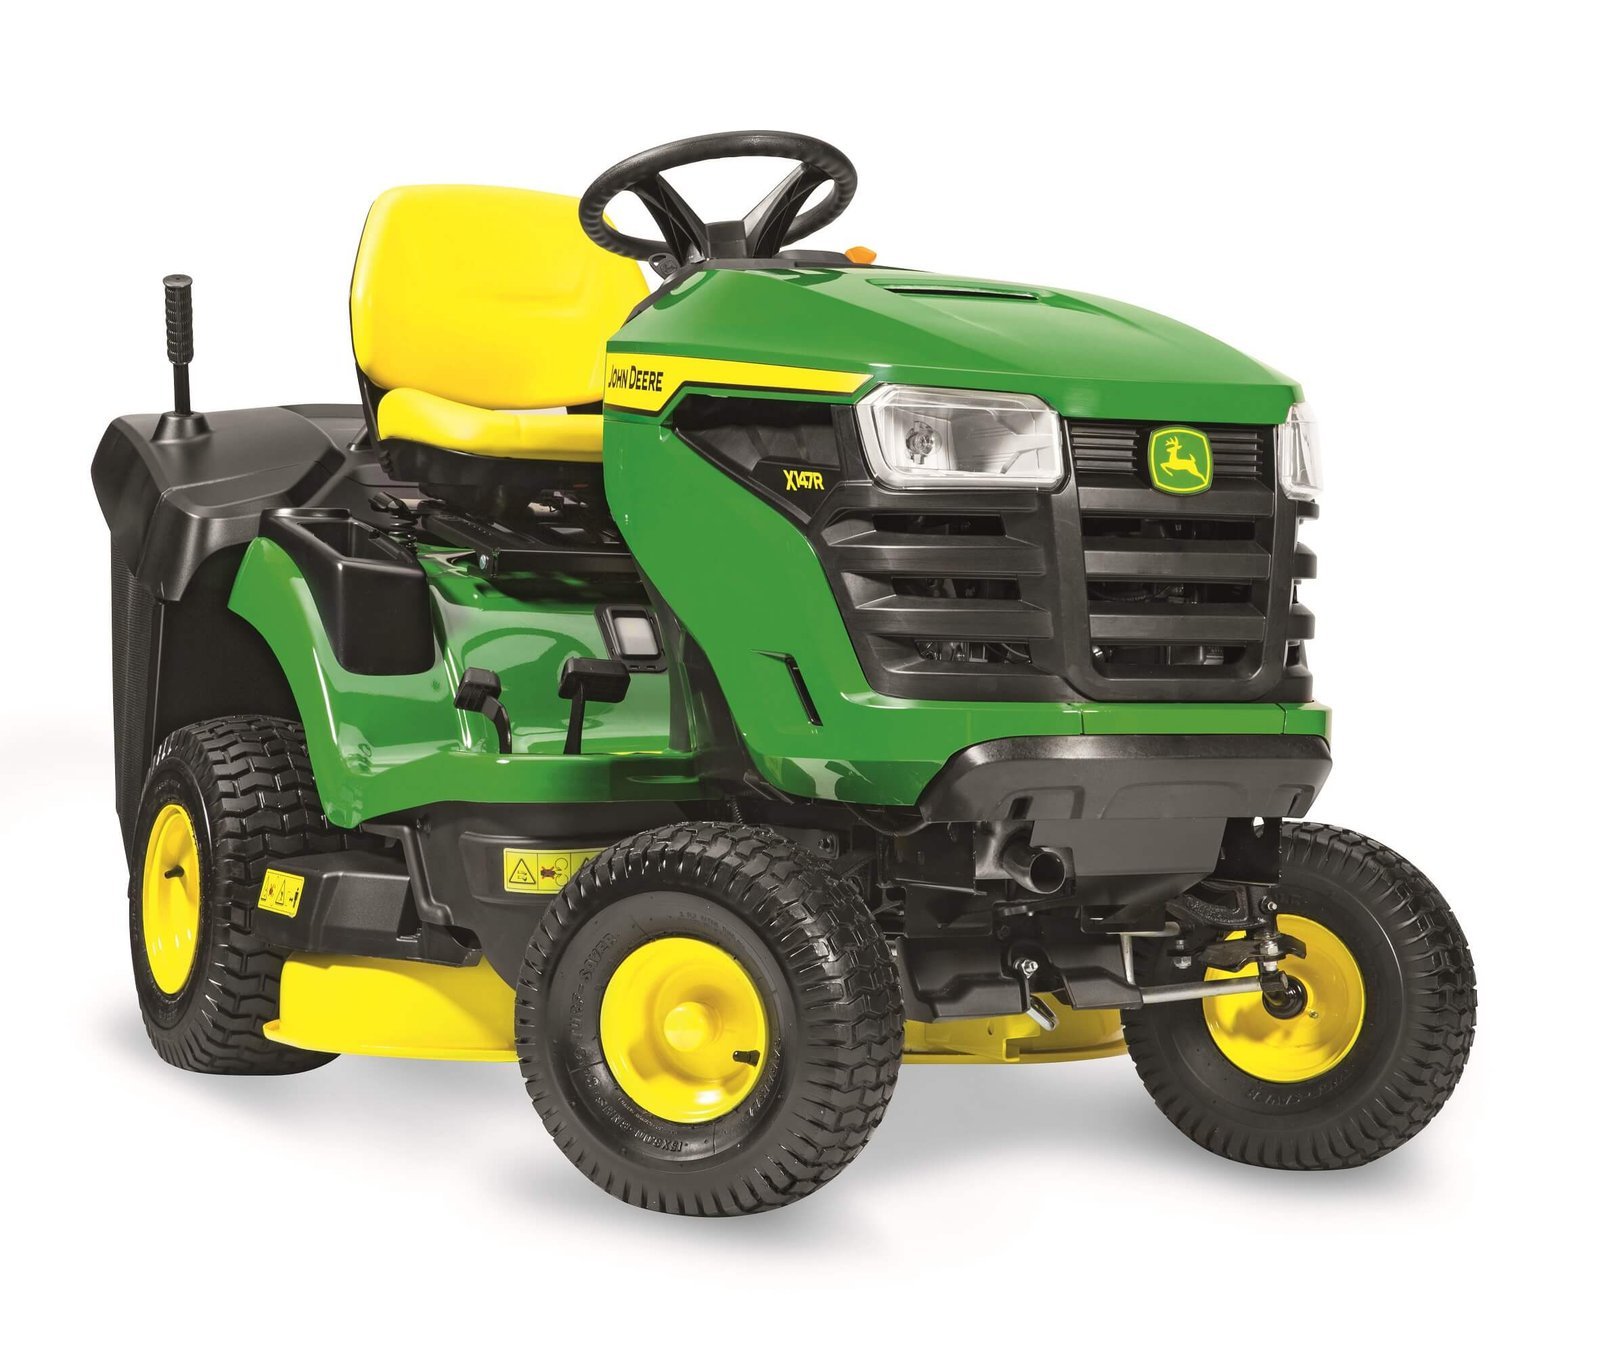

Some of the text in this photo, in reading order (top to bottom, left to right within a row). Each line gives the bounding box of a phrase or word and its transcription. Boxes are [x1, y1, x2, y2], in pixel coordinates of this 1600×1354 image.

[608, 365, 664, 392] JOHN DEERE
[783, 469, 825, 492] X147R
